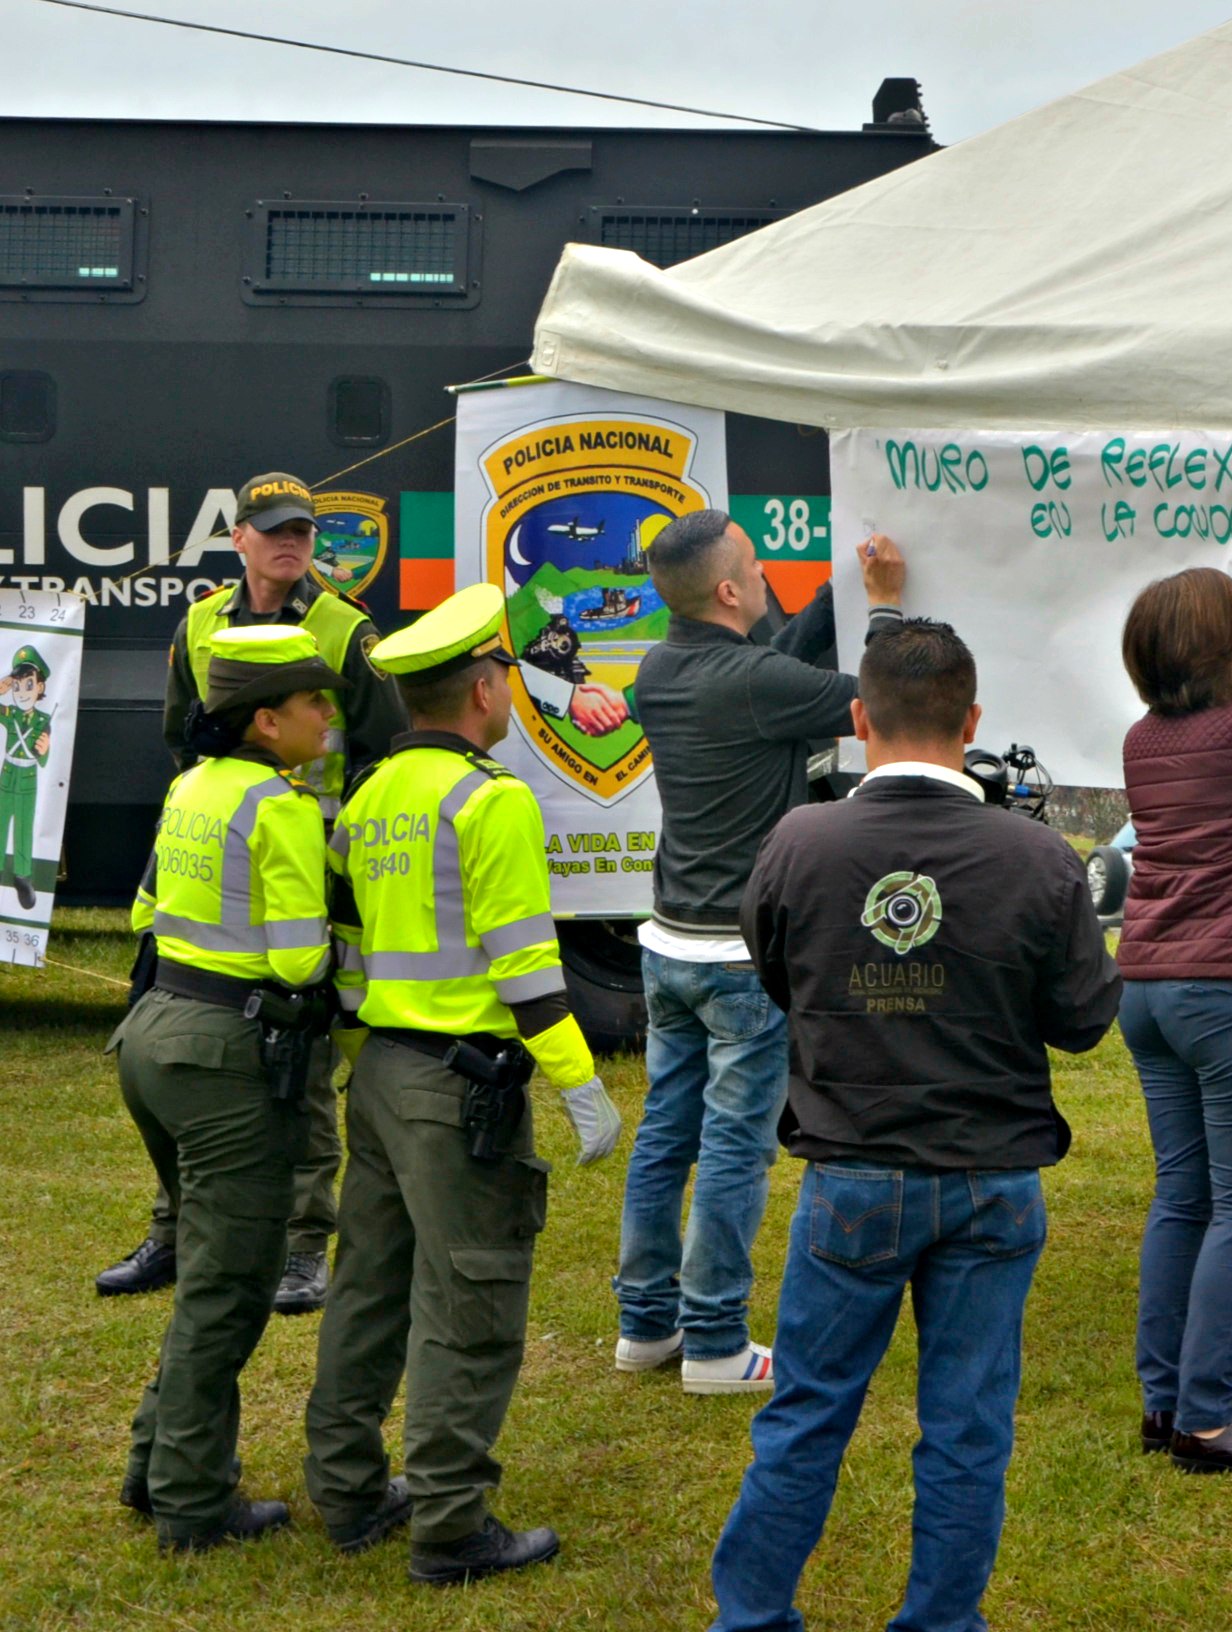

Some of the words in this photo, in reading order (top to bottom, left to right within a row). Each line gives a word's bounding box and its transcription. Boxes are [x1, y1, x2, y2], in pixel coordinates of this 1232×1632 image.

[502, 435, 575, 475] POLICIA
[580, 431, 674, 459] NACIONAL
[1021, 445, 1072, 491] DE
[500, 485, 545, 519] DIRECCION
[547, 481, 561, 491] DE
[564, 475, 612, 489] TRANSITO
[615, 475, 621, 485] Y
[624, 476, 686, 504] TRANSPORTE
[0, 486, 246, 567] ICIA
[763, 498, 831, 551] 38-
[1031, 501, 1072, 539] EN
[1101, 501, 1137, 542] LA
[18, 605, 36, 619] 23
[50, 608, 66, 621] 24
[538, 728, 550, 745] SU
[551, 743, 582, 778] AMIGO
[583, 771, 599, 786] EN
[615, 768, 628, 782] EL
[567, 832, 622, 853] VIDA
[627, 831, 655, 852] EN
[594, 856, 617, 874] En
[621, 856, 656, 873] Con
[6, 929, 20, 944] 35
[24, 933, 40, 947] 36
[849, 962, 945, 988] ACUARIO
[866, 997, 926, 1013] PRENSA
